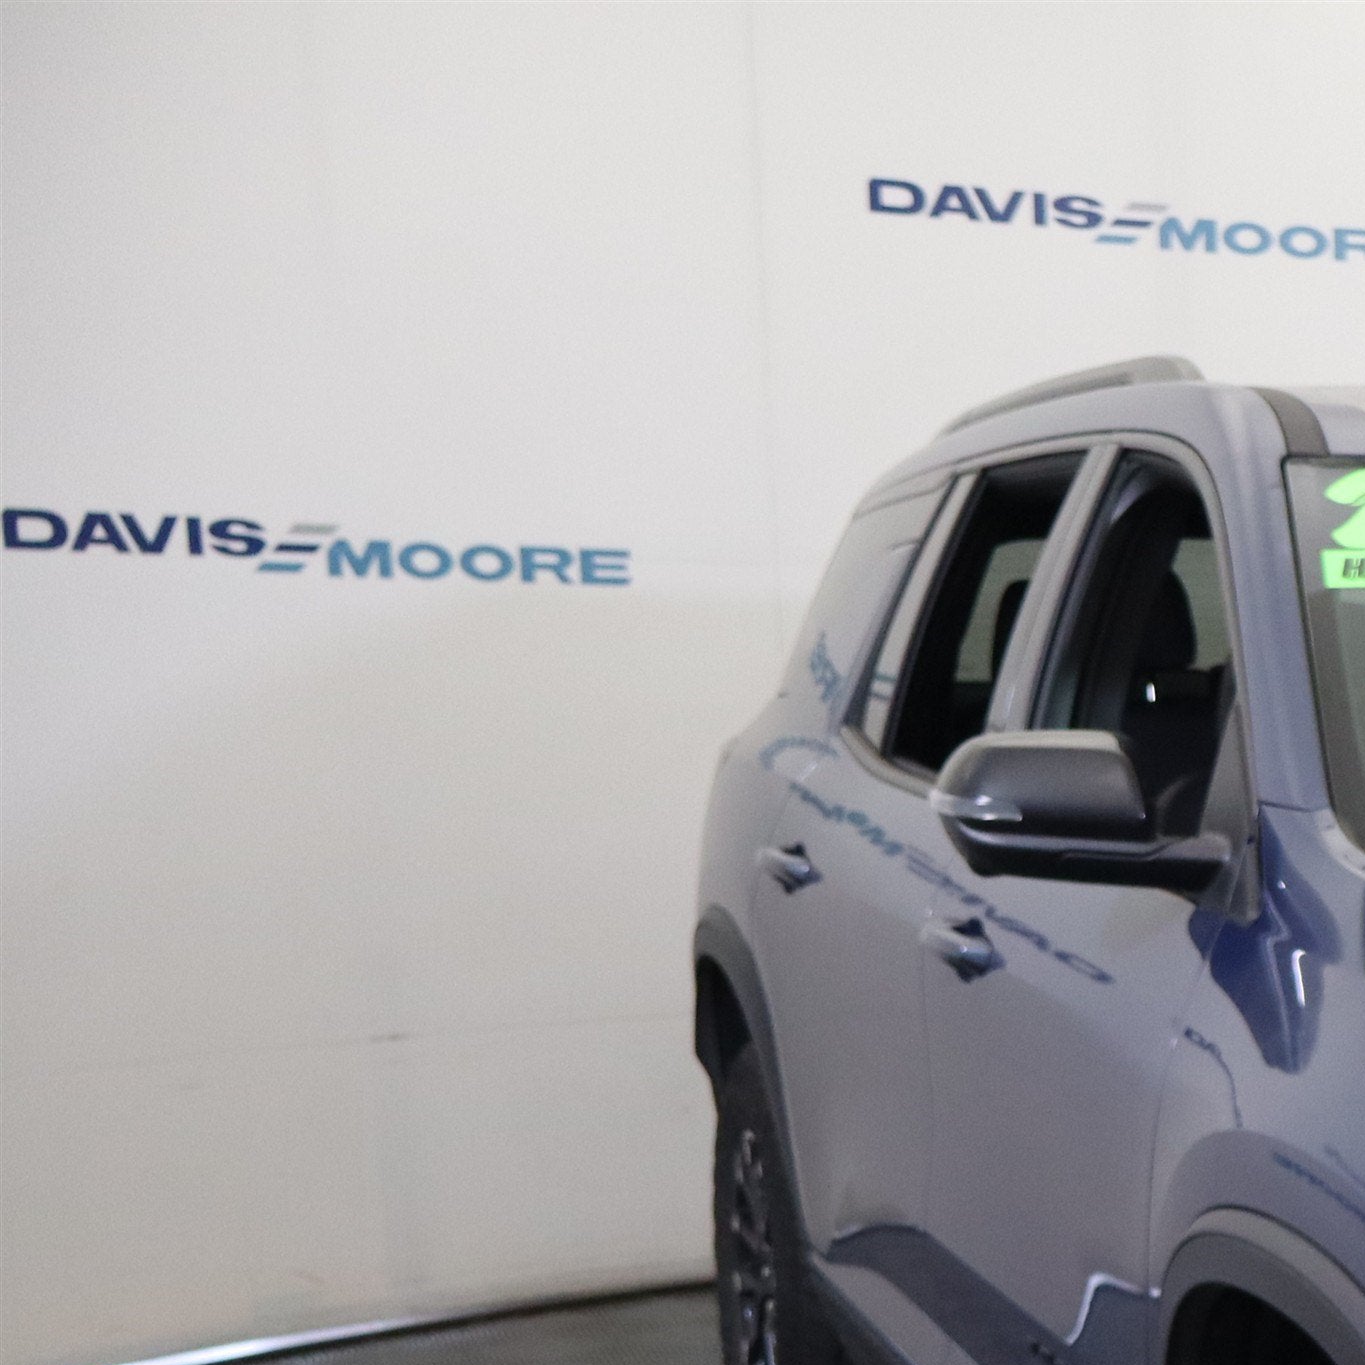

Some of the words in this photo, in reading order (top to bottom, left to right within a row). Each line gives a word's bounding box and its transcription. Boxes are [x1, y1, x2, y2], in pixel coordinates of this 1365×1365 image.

[868, 178, 1102, 229] DAVIS
[2, 508, 267, 556] DAVIS
[329, 540, 631, 586] MOORE
